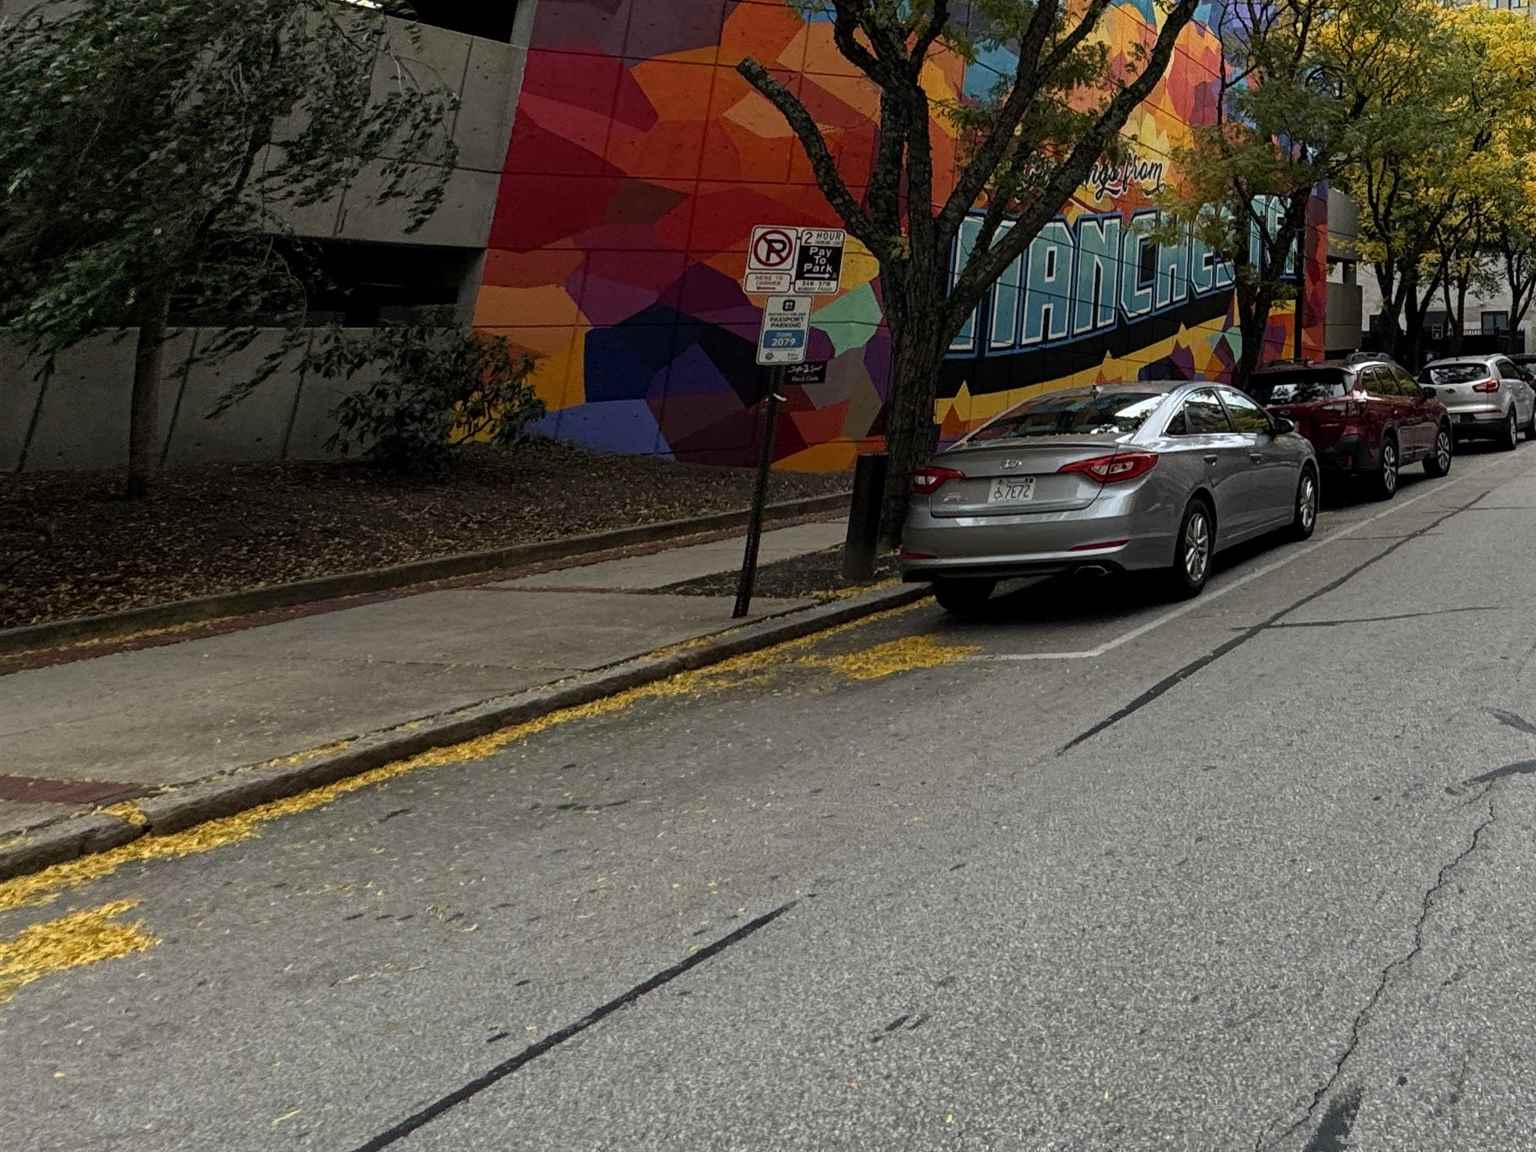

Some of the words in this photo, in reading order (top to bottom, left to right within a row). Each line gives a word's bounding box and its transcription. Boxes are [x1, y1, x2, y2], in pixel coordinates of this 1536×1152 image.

[804, 231, 813, 245] 2
[816, 231, 842, 241] HOUR
[809, 246, 832, 258] Pay
[814, 256, 827, 264] To
[803, 263, 833, 273] Park
[771, 337, 797, 347] 2079
